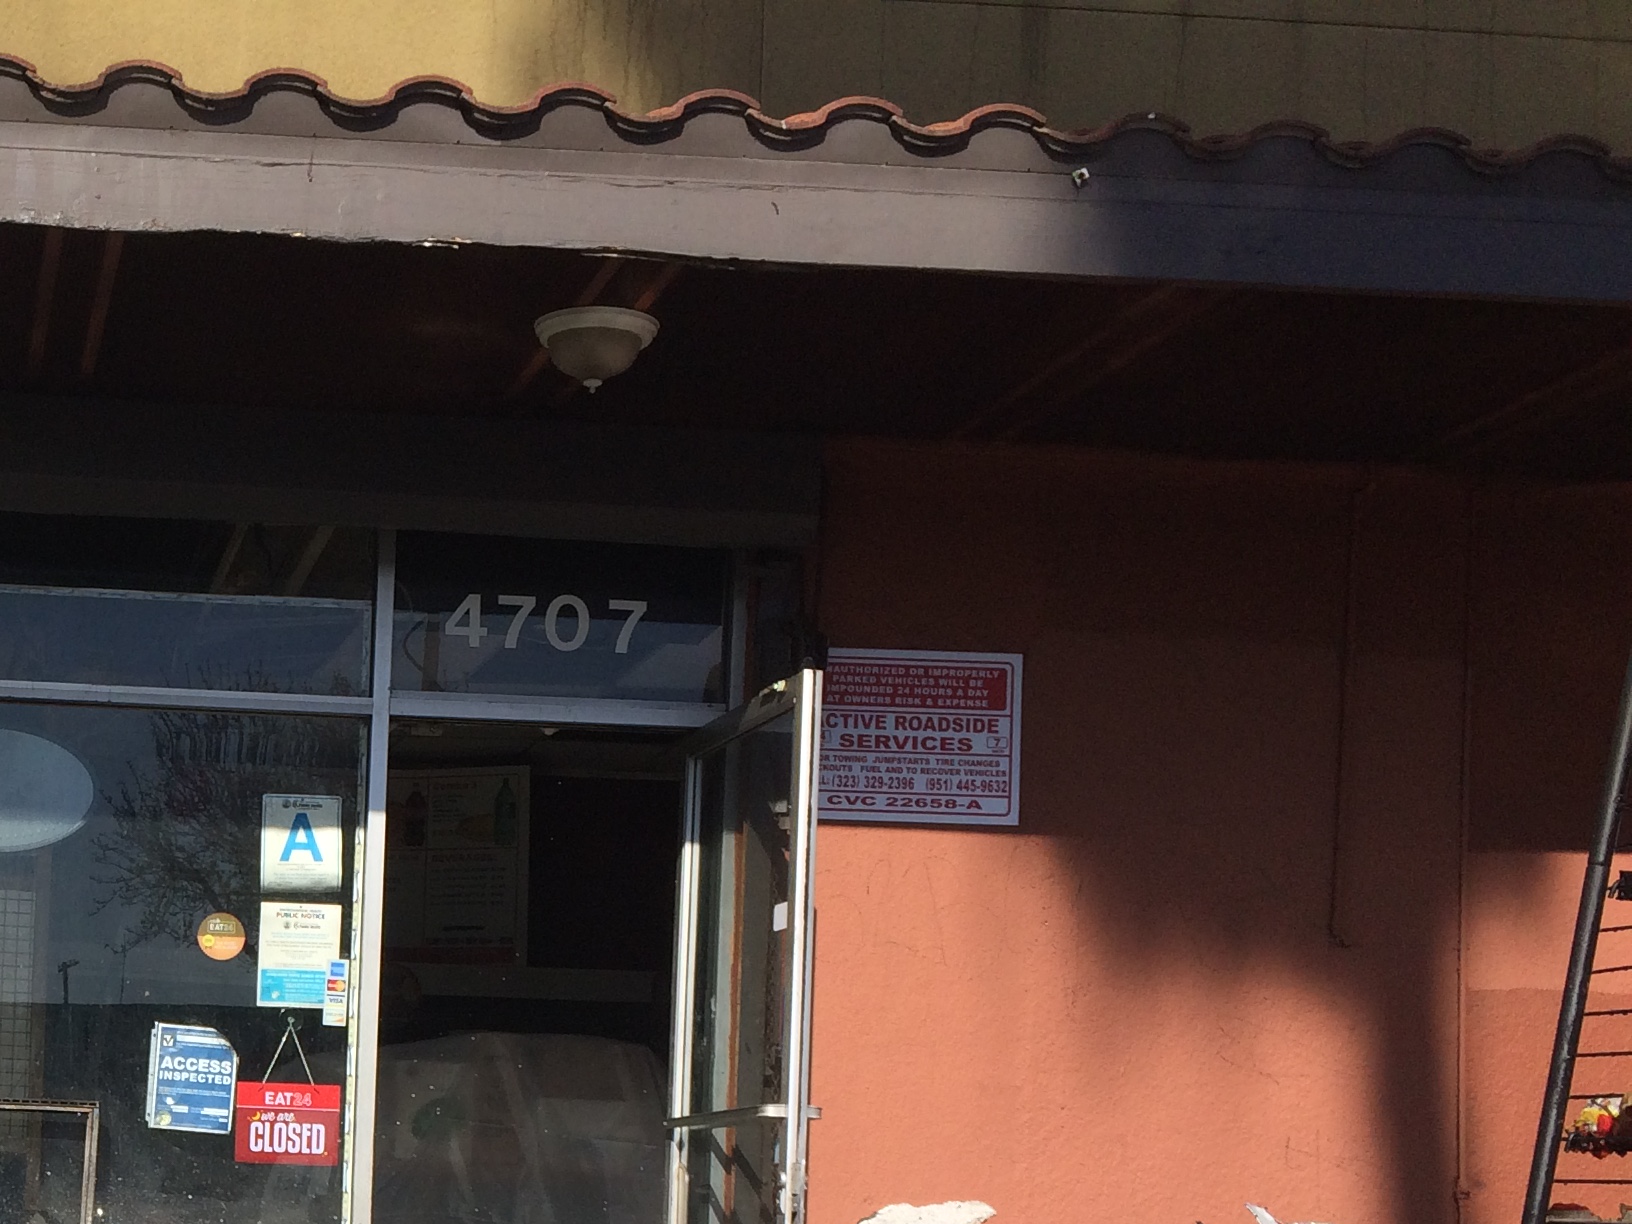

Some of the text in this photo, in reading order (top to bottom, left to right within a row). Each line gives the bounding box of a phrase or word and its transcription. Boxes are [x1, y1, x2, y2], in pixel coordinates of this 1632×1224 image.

[444, 593, 648, 654] 4707
[825, 665, 1000, 679] NAUTHORIZED OR IMPROPERLY
[832, 674, 984, 688] PARKED VEHICLES WILL BE
[826, 685, 989, 698] IMPOUNDED 24 HOURS A DAY
[826, 694, 841, 703] AT
[844, 695, 892, 705] OWNERS
[895, 697, 922, 706] RISK
[937, 698, 989, 708] EXPENSE
[821, 712, 1000, 734] CTIVE ROADSIDE
[838, 733, 974, 752] SERVICES
[832, 755, 868, 764] TOWING
[872, 756, 931, 766] JUMPSTARTS
[935, 758, 956, 767] TIRE
[957, 759, 1001, 768] CHANGES
[859, 765, 883, 774] FUEL
[884, 766, 904, 774] AND
[906, 766, 918, 775] TO
[920, 767, 962, 777] RECOVER
[963, 768, 1007, 778] VEHICLES
[831, 774, 861, 788] (323)
[863, 775, 915, 791] 329-2396
[925, 777, 954, 792] (951)
[956, 778, 1008, 794] 445-9632
[826, 794, 983, 811] CVC 22658-A
[279, 812, 324, 862] A
[301, 912, 325, 920] NOTICE
[160, 1055, 232, 1075] ACCESS
[159, 1070, 232, 1086] INSPECTED
[264, 1091, 312, 1107] EAT24
[249, 1121, 326, 1155] CLOSED
